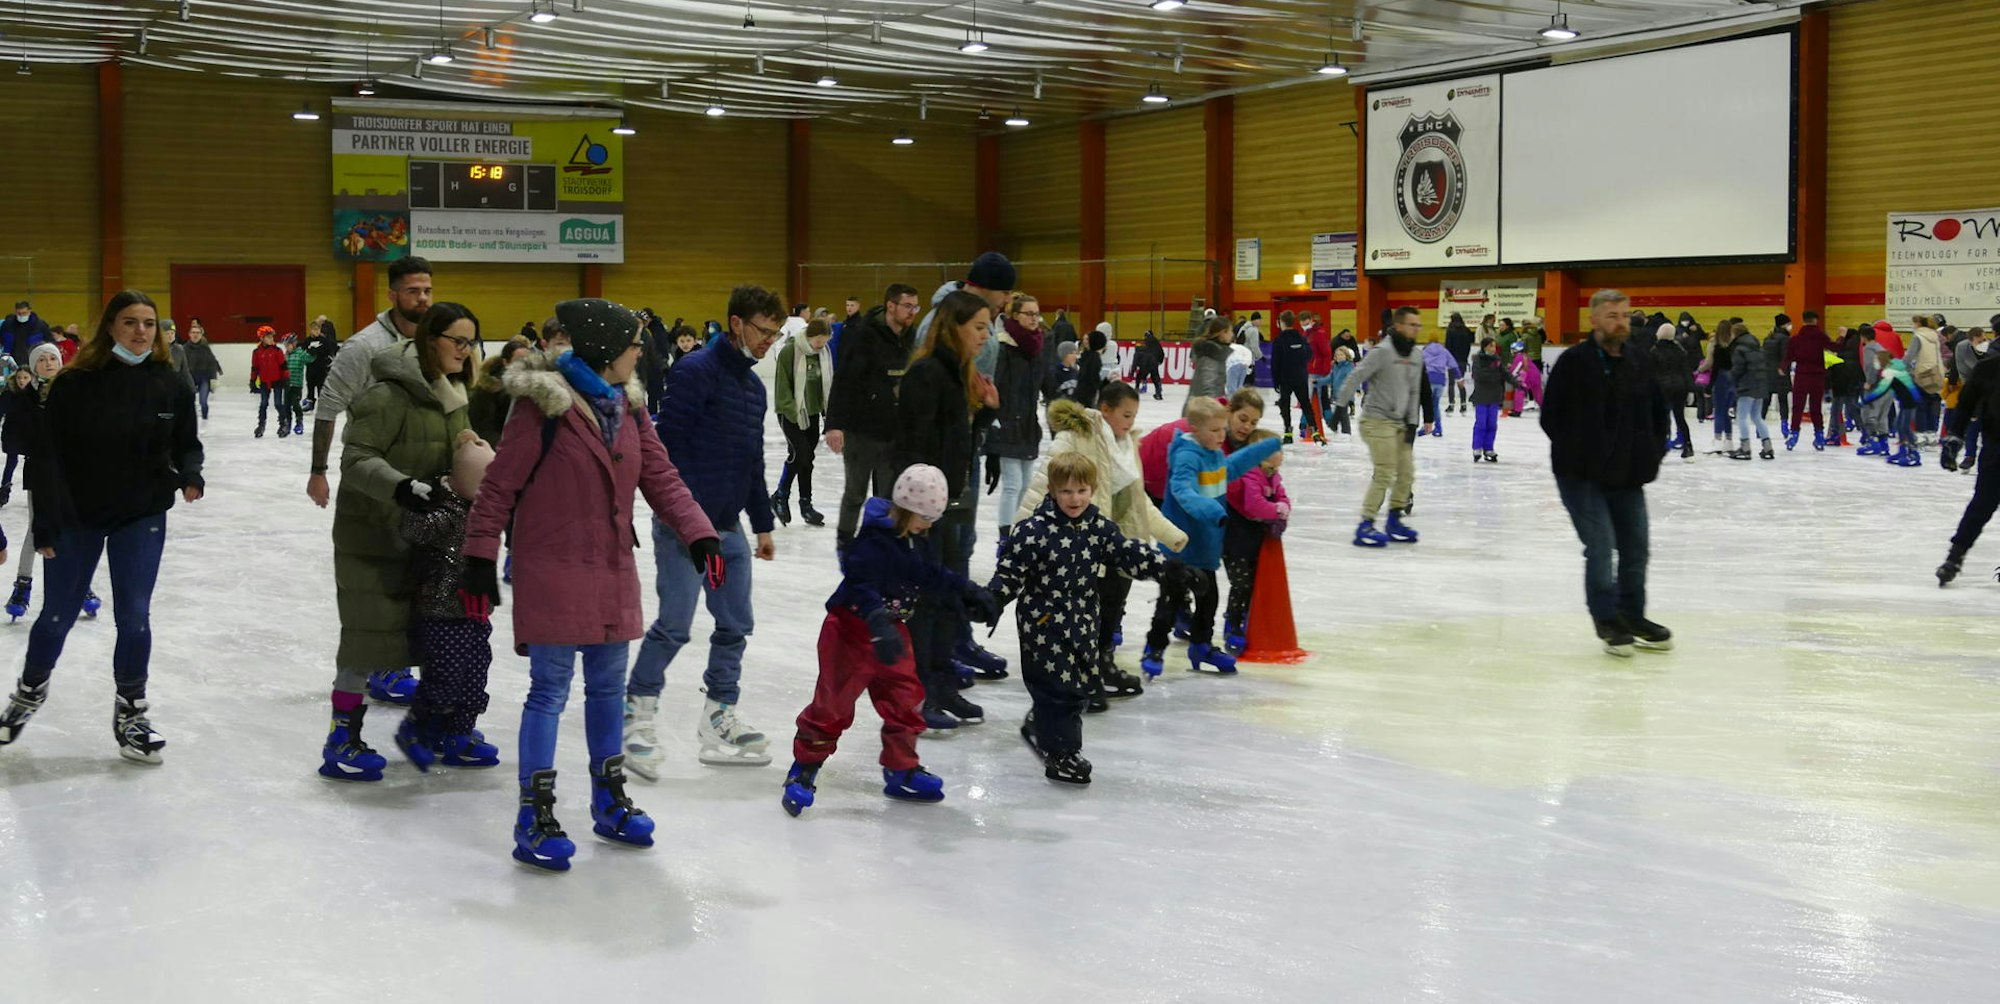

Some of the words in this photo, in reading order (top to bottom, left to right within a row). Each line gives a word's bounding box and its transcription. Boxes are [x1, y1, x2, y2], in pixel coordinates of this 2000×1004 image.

[352, 116, 423, 131] TROISDORFER
[426, 120, 457, 132] SPORT
[461, 122, 479, 133] HAT
[483, 123, 511, 134] EINEN
[1417, 122, 1443, 132] EHC
[352, 134, 415, 151] PARTNER
[420, 137, 470, 153] VOLLER
[475, 139, 530, 155] ENERGIE
[470, 165, 503, 180] 15:18
[451, 181, 459, 191] H
[508, 182, 517, 192] G
[562, 177, 612, 187] STADTWERKE
[562, 185, 612, 195] TROISDORF
[417, 225, 450, 235] Rutschen
[451, 226, 463, 235] Sie
[464, 226, 477, 235] mit
[478, 228, 492, 236] uns
[565, 227, 610, 242] AGGUA
[416, 239, 447, 249] AGGUA
[449, 240, 477, 250] Bade-
[479, 240, 497, 250] und
[499, 241, 548, 252] Saunapark
[1891, 249, 1959, 260] TECHNOLOGY
[1967, 249, 1988, 257] FOR
[1888, 296, 1961, 305] VIDEO/MEDIEN
